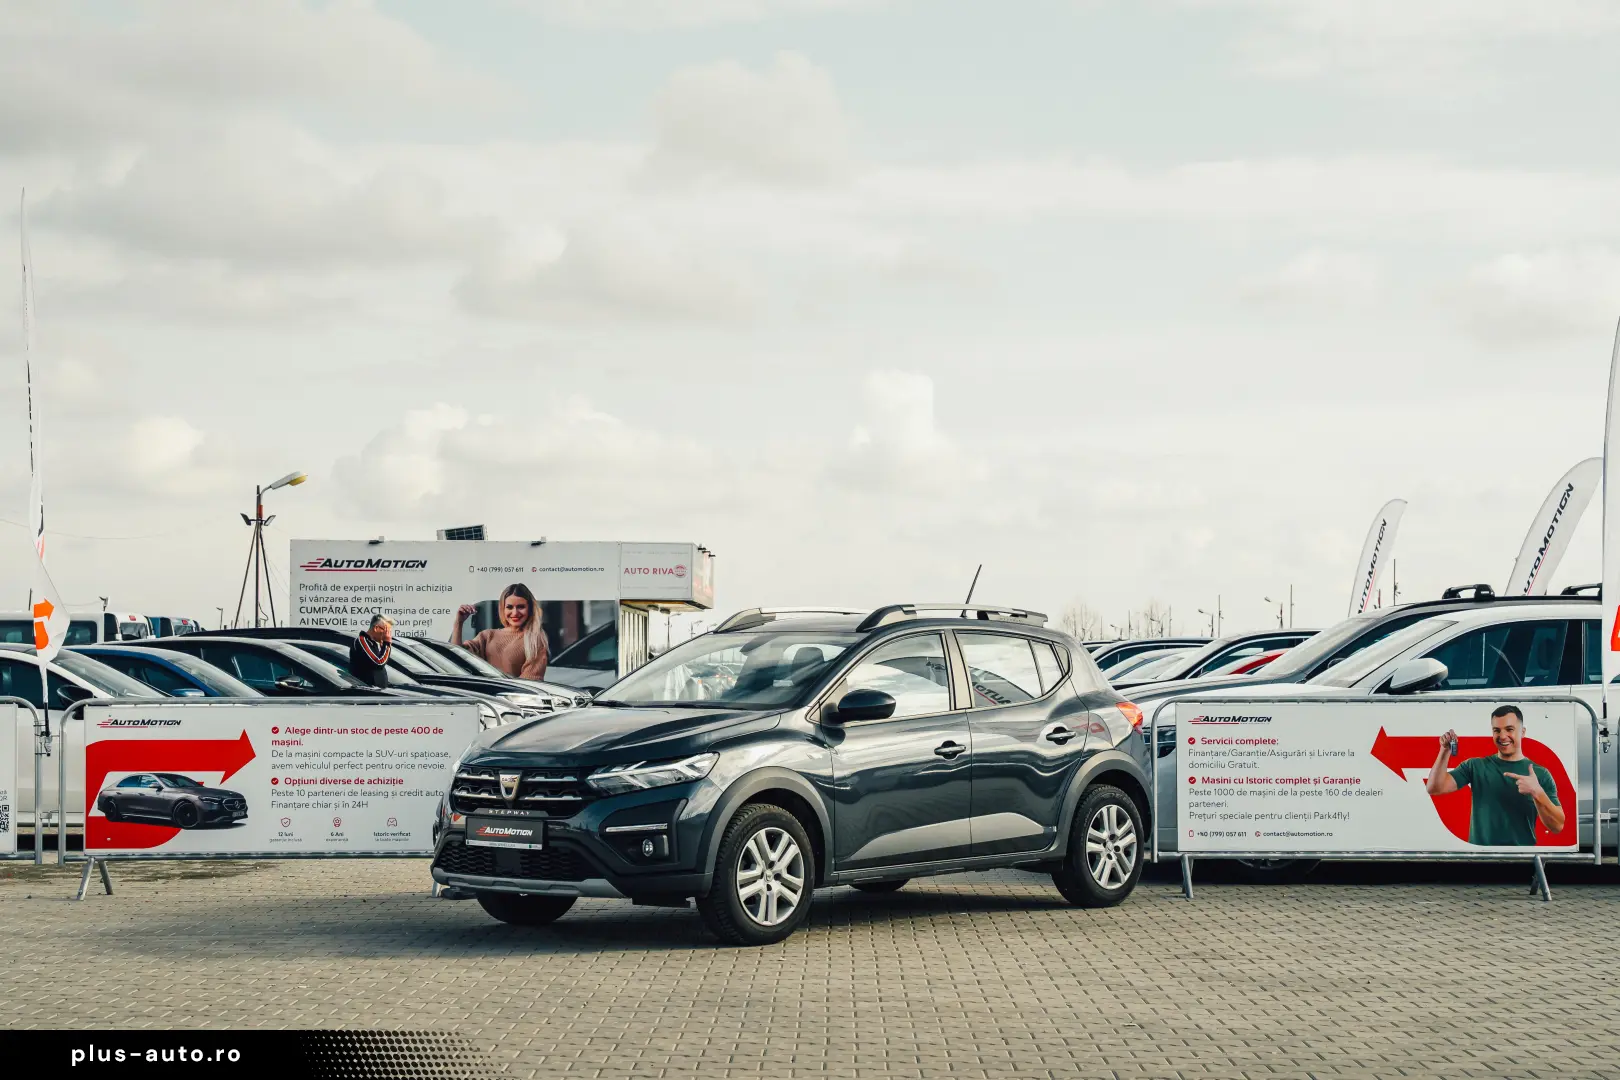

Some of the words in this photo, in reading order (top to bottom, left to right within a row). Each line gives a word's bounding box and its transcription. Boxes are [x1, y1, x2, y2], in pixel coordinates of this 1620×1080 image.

[1522, 482, 1574, 595] UTOMOTION
[320, 559, 427, 568] AUTOMOTION
[300, 583, 327, 591] Profită
[416, 584, 452, 592] achiziția
[300, 595, 306, 603] și
[300, 605, 348, 614] CUMPĂRĂ
[385, 607, 416, 615] mașina
[285, 728, 311, 736] Alege
[1235, 737, 1278, 747] complete:
[295, 750, 320, 760] mașini
[323, 751, 364, 760] compacte
[333, 762, 362, 771] perfect
[366, 763, 392, 771] pentru
[284, 778, 317, 786] Opțiuni
[367, 777, 403, 786] achiziție
[1275, 776, 1311, 786] complet
[1323, 777, 1360, 786] Garanție
[308, 790, 345, 798] parteneri
[361, 789, 388, 798] leasing
[1250, 789, 1275, 798] mașini
[1300, 790, 1322, 798] peste
[272, 801, 309, 810] Finanțare
[1189, 801, 1228, 809] parteneri.
[1190, 812, 1216, 822] Prețuri
[1220, 812, 1252, 821] speciale
[1254, 813, 1282, 821] pentru
[1314, 812, 1349, 822] Park4fly!
[484, 826, 533, 836] AUTOMOTION
